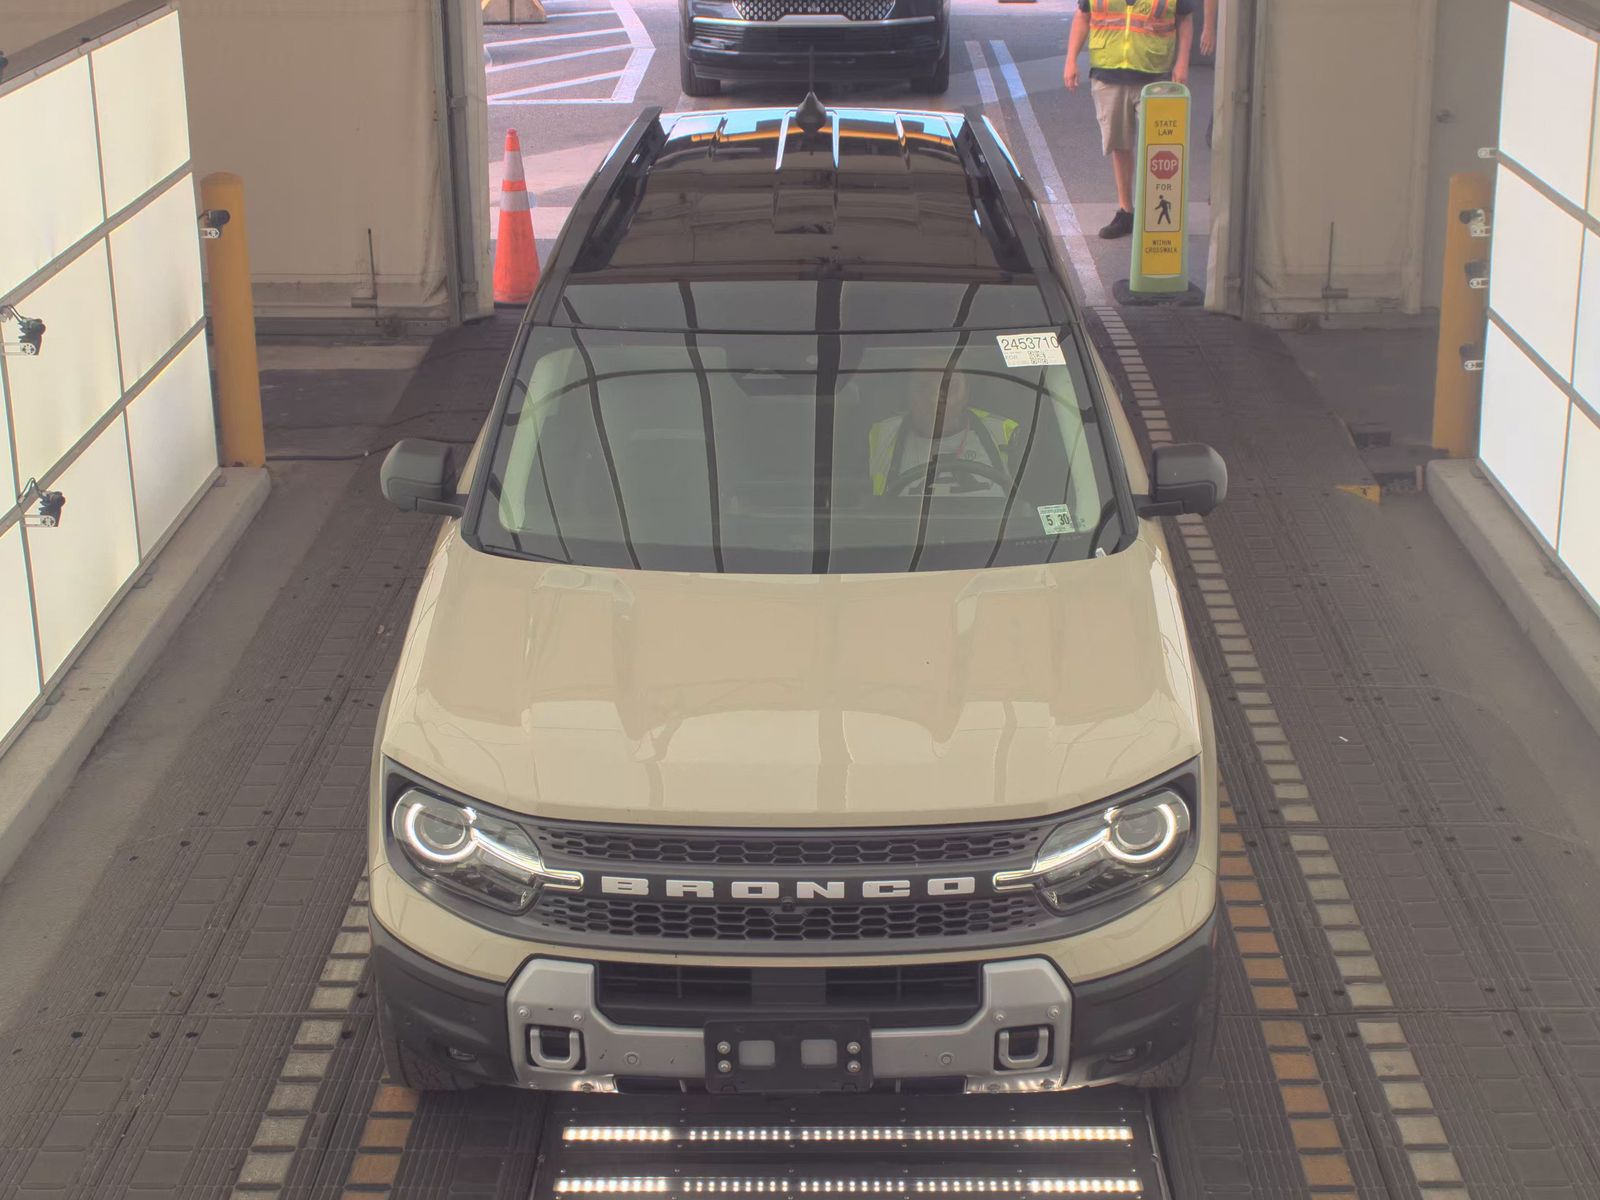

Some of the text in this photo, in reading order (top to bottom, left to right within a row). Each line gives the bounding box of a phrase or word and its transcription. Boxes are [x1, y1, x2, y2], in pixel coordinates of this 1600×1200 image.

[1151, 159, 1178, 171] STOP
[1156, 183, 1172, 191] FOR
[1001, 336, 1060, 350] 2453710
[1046, 513, 1070, 526] 5 30
[601, 875, 976, 899] BRONCO
